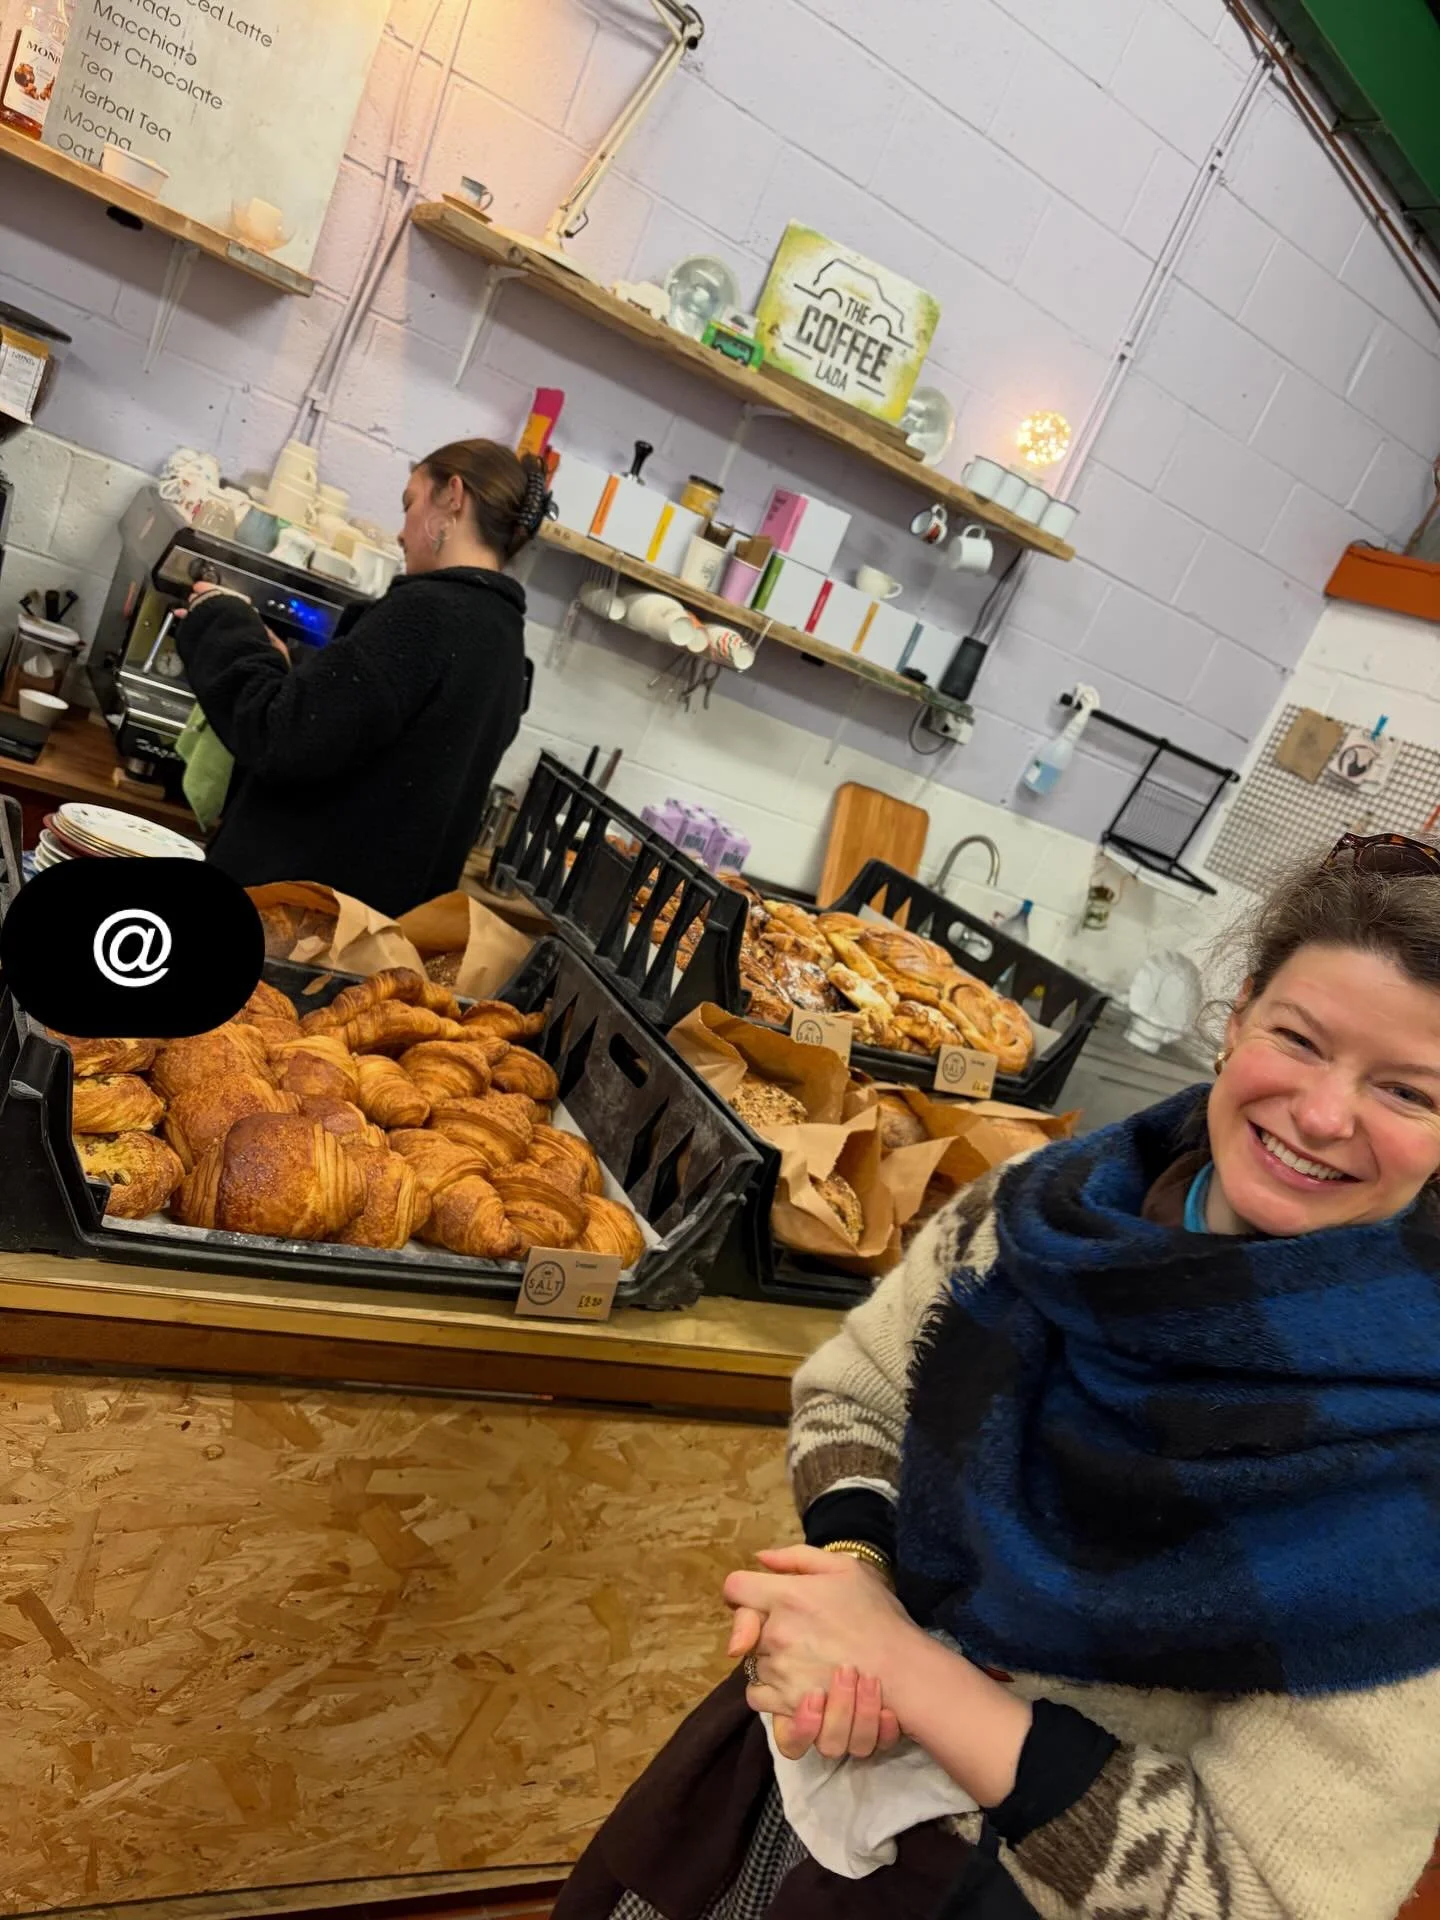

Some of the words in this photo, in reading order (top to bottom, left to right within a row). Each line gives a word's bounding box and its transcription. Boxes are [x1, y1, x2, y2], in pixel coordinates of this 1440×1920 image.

[92, 0, 197, 66] Macchiato
[227, 11, 273, 48] Latte
[27, 40, 61, 64] MONI
[79, 51, 114, 83] Tea
[86, 26, 121, 55] Hot
[125, 47, 223, 110] Chocolate
[63, 105, 133, 151] Mocha
[71, 79, 135, 123] Herbal
[140, 112, 172, 143] Tea
[57, 132, 94, 162] Oat
[844, 297, 871, 325] THE
[795, 305, 893, 382] COFFEE
[815, 360, 849, 391] LADA
[528, 1278, 563, 1291] SALT
